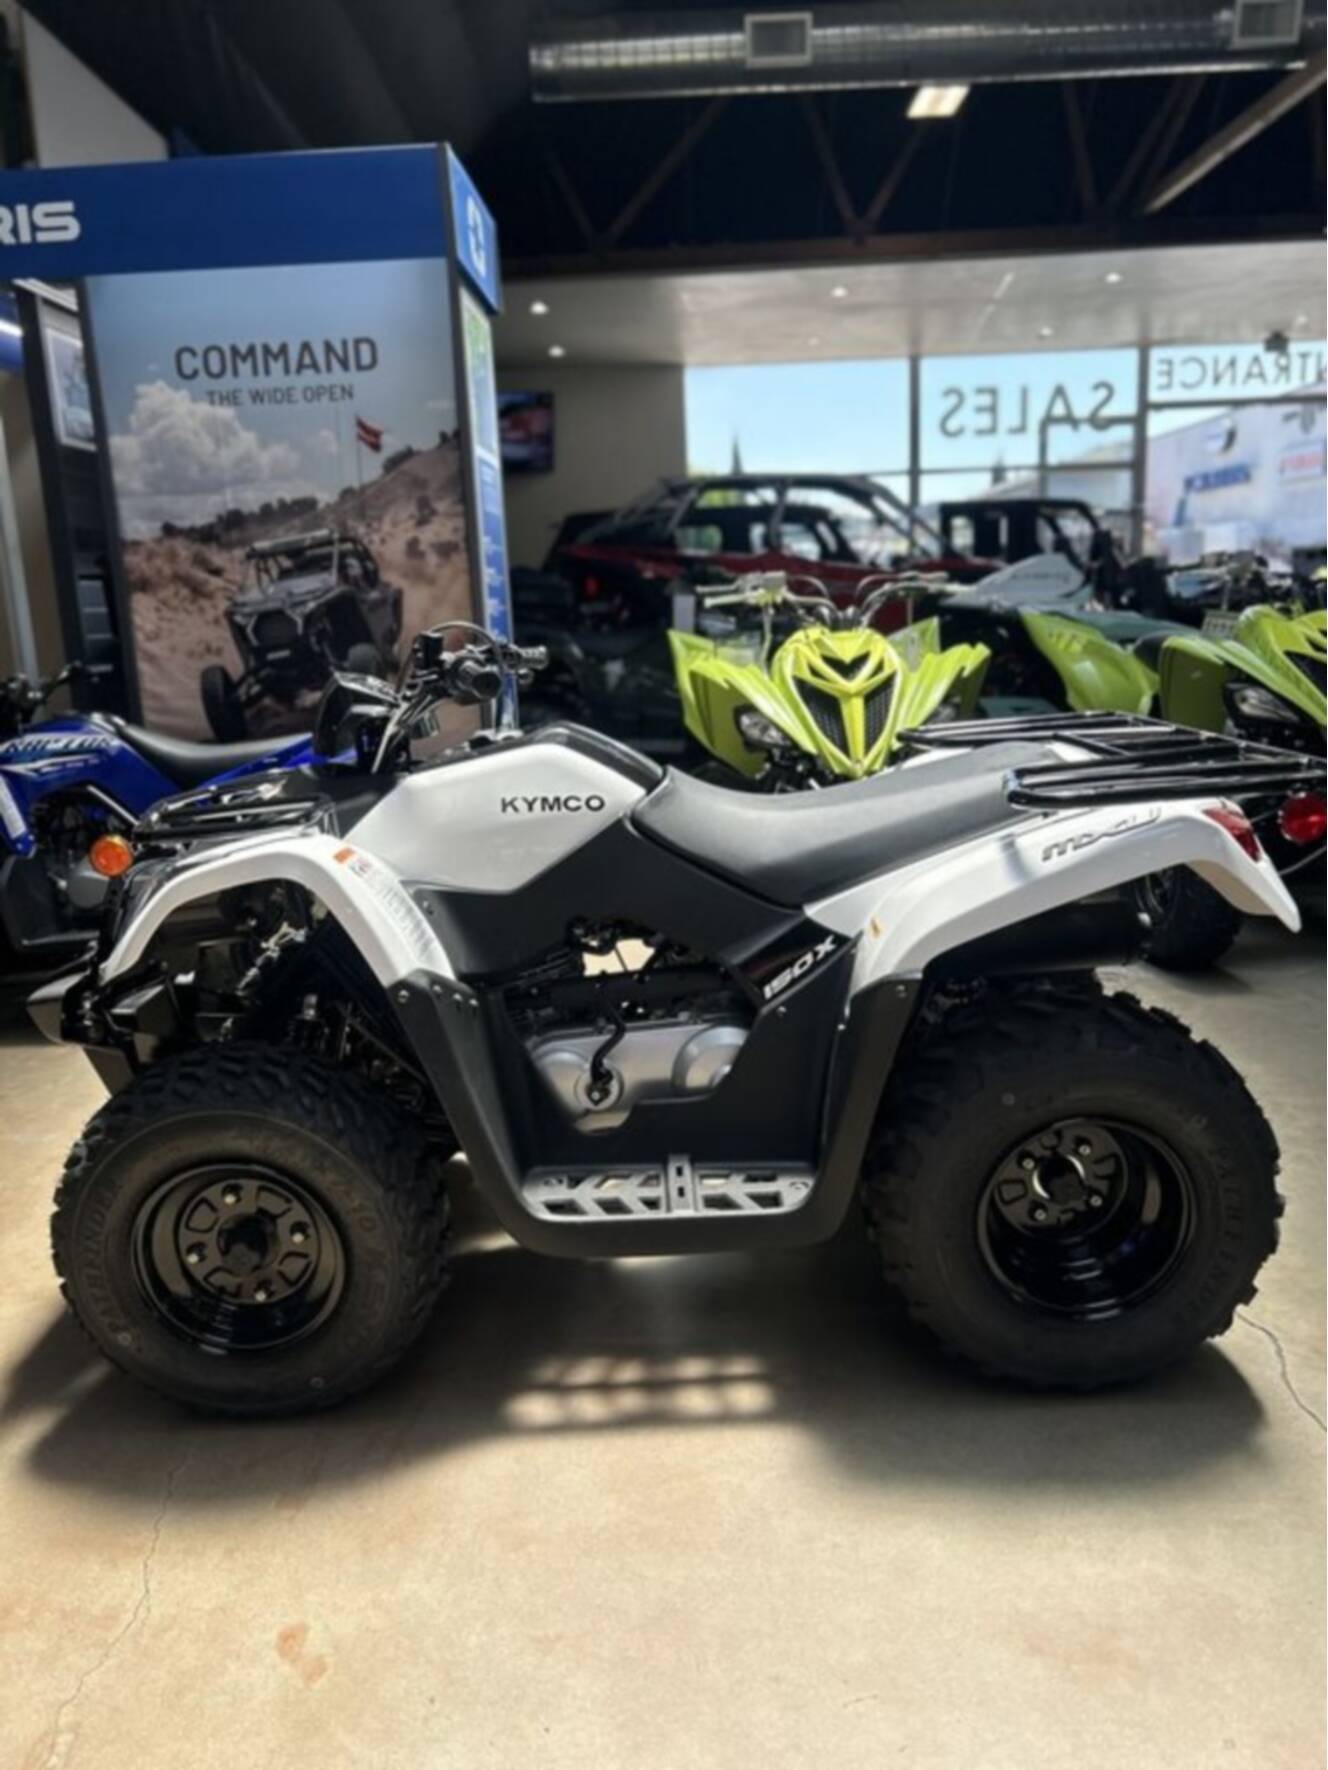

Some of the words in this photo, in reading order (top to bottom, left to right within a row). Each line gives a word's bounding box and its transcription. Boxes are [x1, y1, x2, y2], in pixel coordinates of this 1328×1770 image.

[175, 337, 378, 380] COMMAND
[206, 389, 243, 407] THE
[248, 386, 298, 405] WIDE
[302, 383, 354, 403] OPEN
[500, 795, 606, 814] KYMCO
